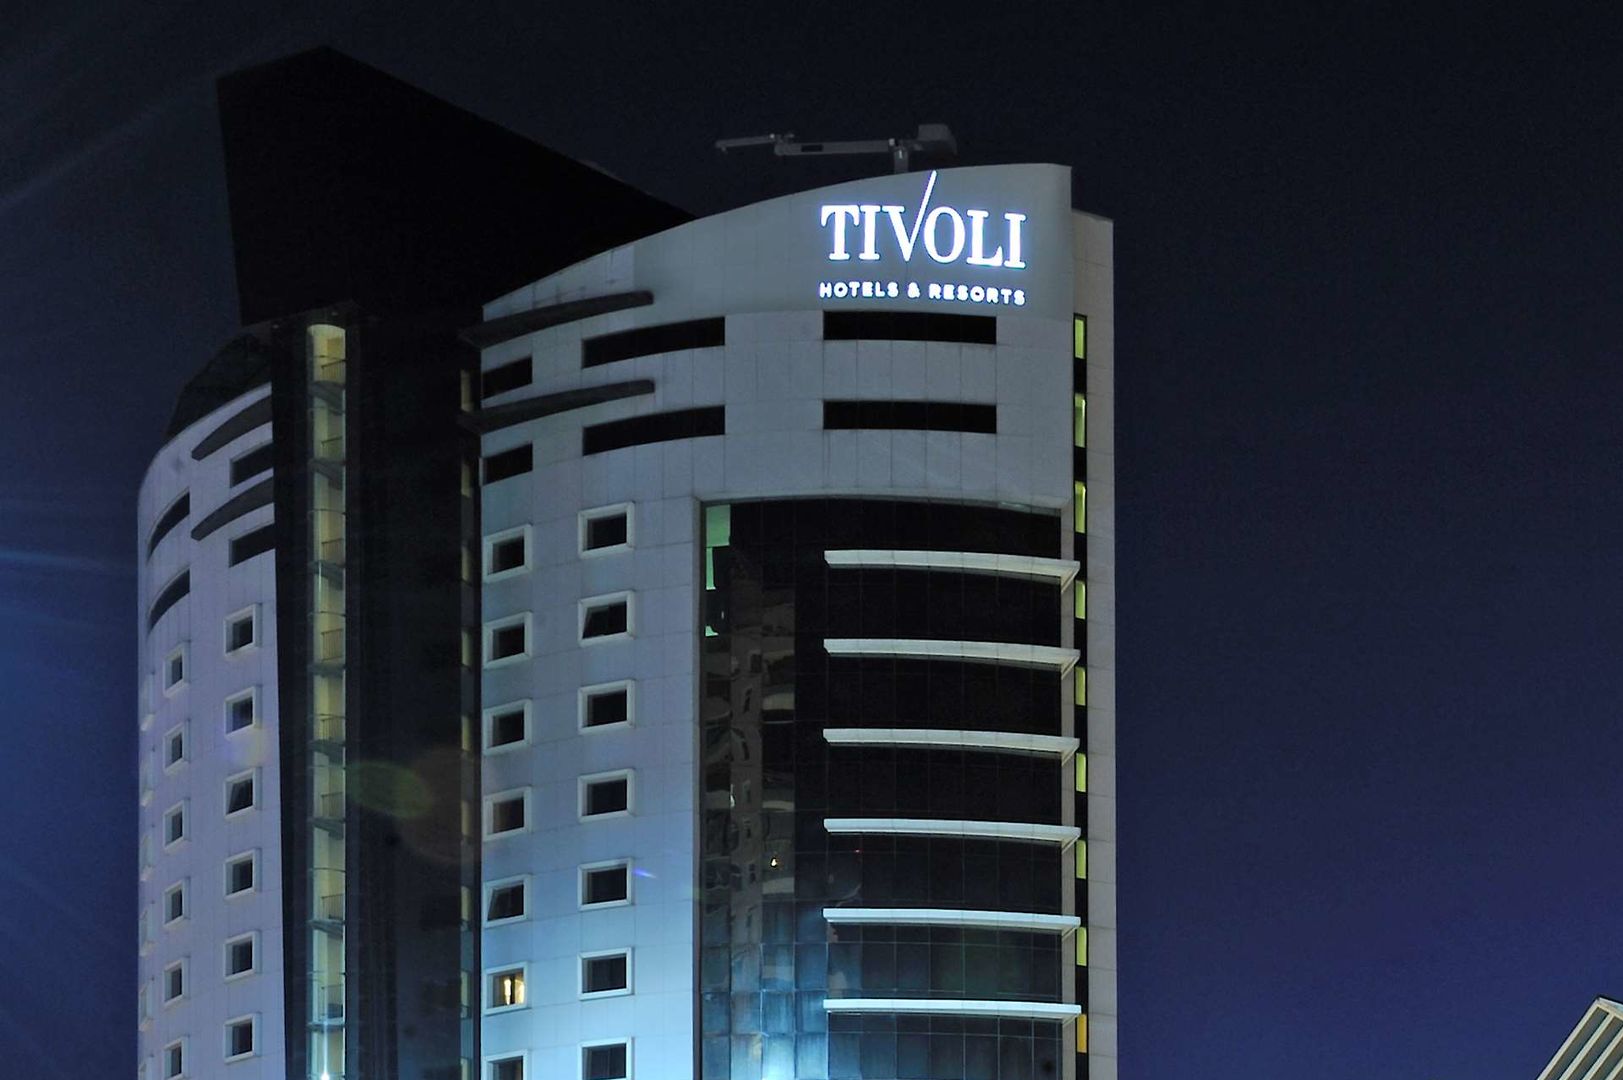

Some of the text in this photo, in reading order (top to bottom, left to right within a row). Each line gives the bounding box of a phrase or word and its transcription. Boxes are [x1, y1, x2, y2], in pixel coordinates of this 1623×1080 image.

[820, 169, 1027, 269] TIVOLI
[819, 281, 1026, 306] HOTELS & RESORTS
